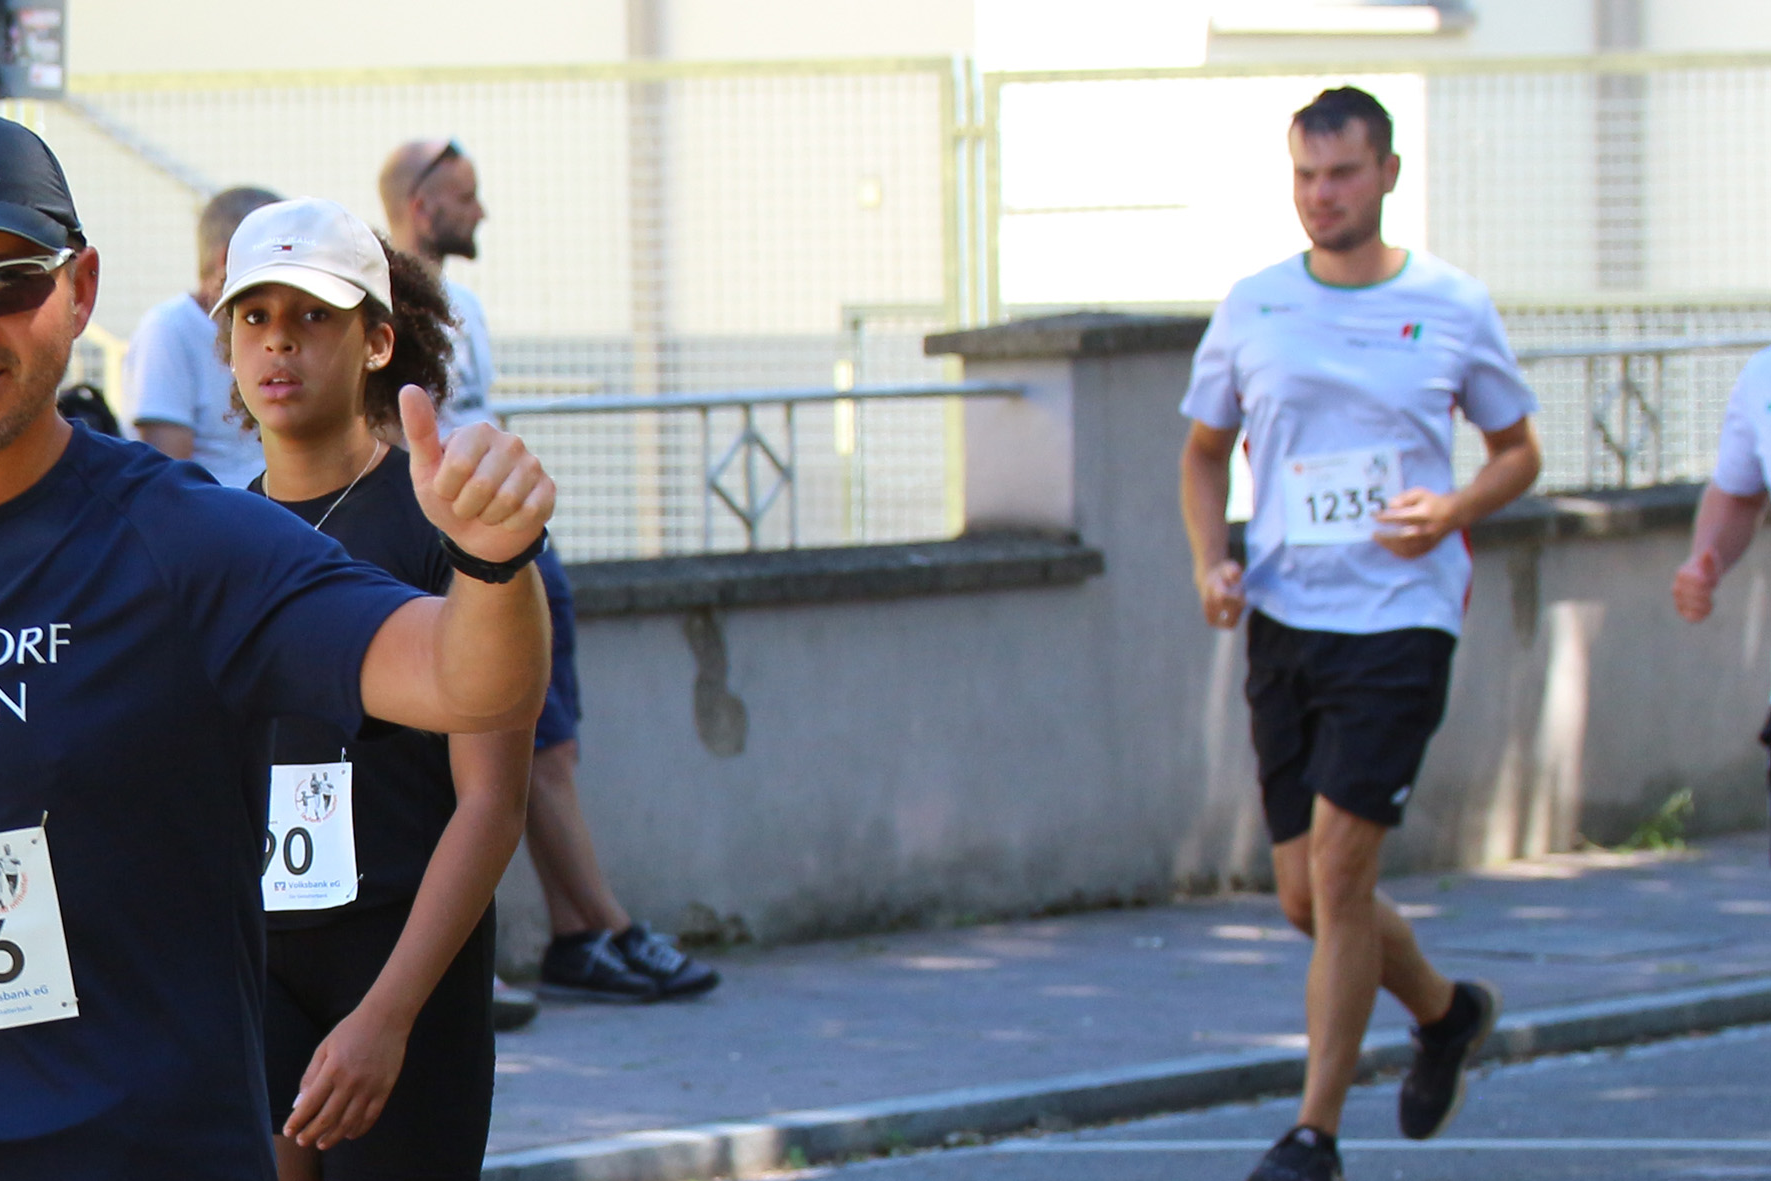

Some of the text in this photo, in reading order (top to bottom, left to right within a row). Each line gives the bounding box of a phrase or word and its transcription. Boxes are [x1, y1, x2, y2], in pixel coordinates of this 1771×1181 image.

[1306, 486, 1388, 523] 1235
[288, 880, 327, 889] Volksbank
[34, 985, 49, 996] eG
